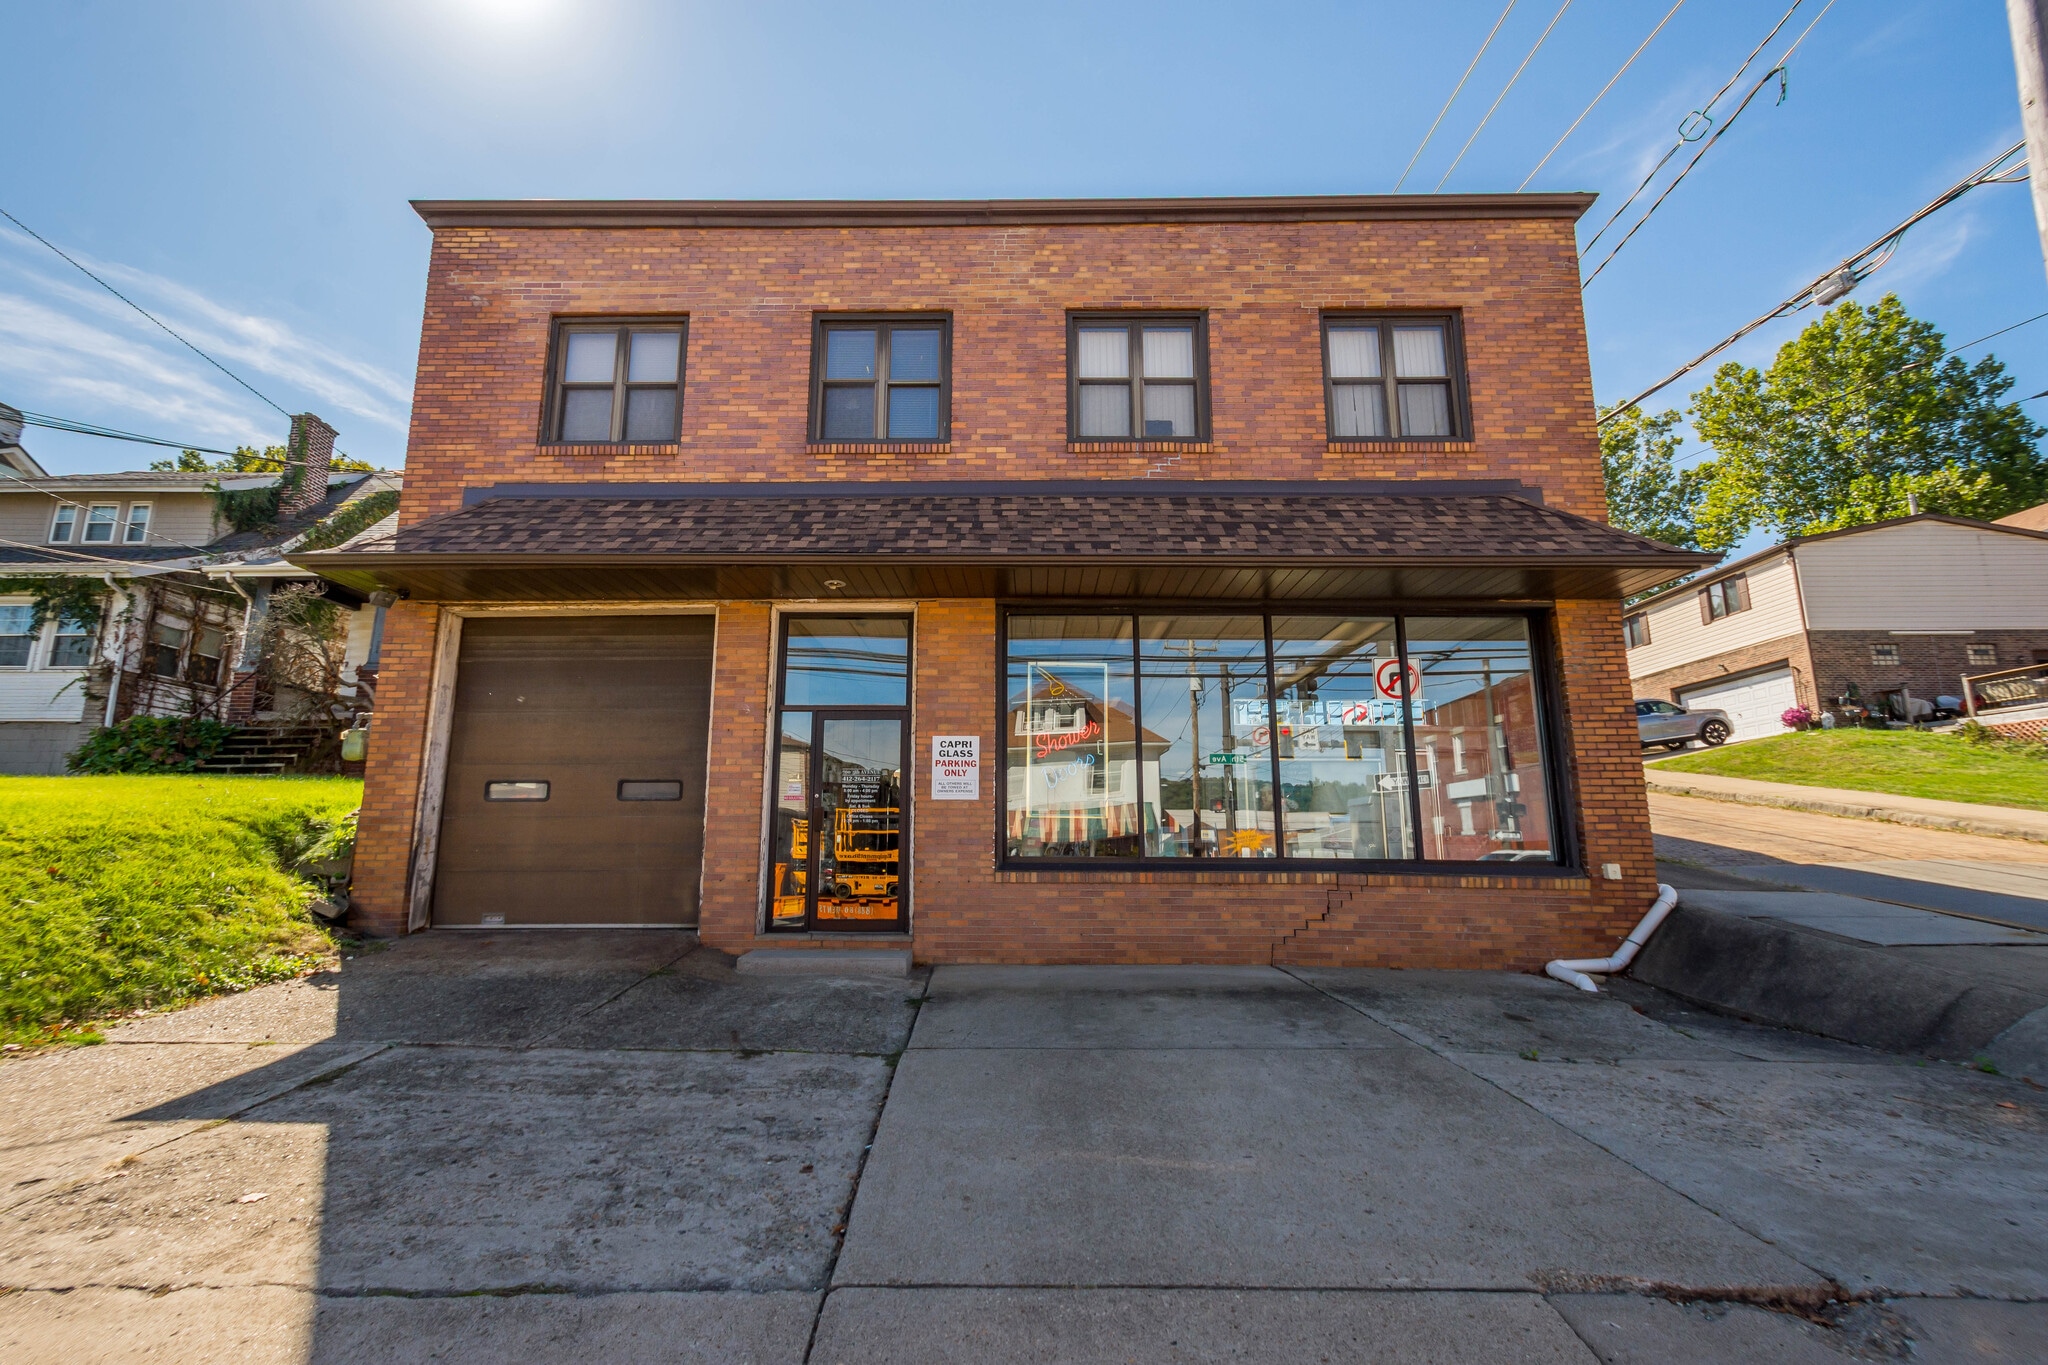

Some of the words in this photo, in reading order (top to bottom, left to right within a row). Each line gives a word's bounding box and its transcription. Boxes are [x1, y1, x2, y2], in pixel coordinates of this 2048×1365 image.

[1036, 720, 1100, 758] Shower
[940, 740, 972, 748] CAPRI
[938, 749, 973, 758] GLASS
[935, 759, 977, 768] PARKING
[944, 769, 968, 777] ONLY
[1041, 753, 1095, 789] Doors
